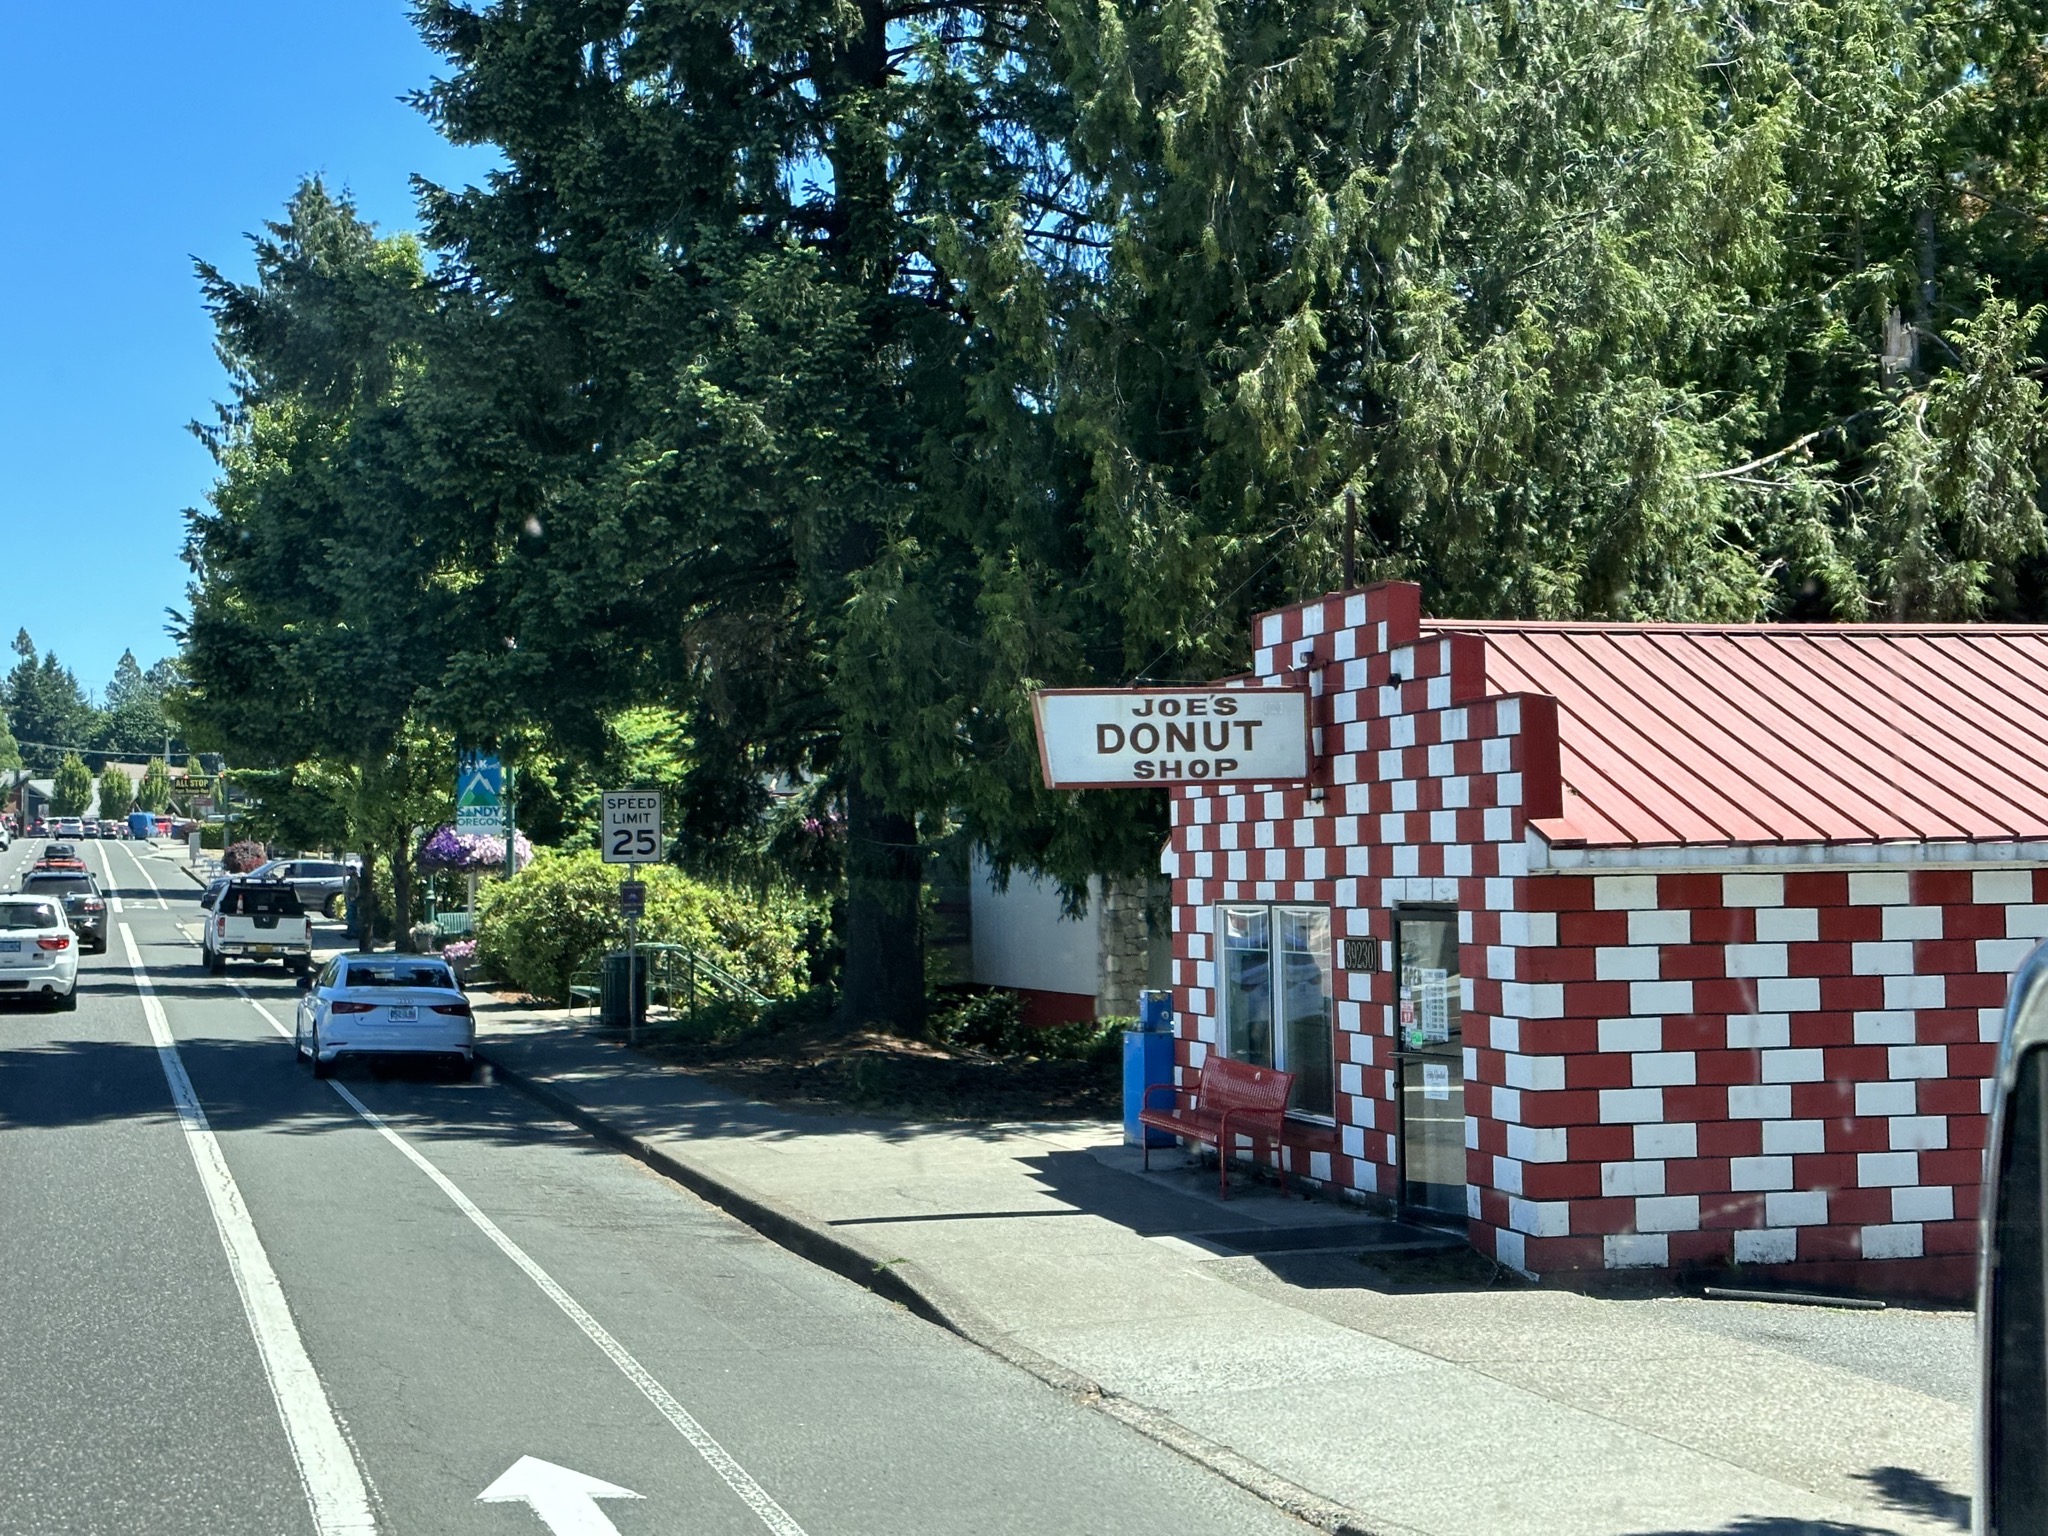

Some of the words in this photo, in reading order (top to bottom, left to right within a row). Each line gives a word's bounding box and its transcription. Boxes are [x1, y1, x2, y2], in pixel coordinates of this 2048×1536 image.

[1131, 694, 1239, 718] JOE'S
[1096, 720, 1263, 755] DONUT
[1133, 758, 1239, 780] SHOP
[190, 779, 209, 788] STOP
[457, 806, 501, 817] SANDY
[607, 798, 657, 810] SPEED
[457, 817, 503, 827] OREGON
[612, 812, 652, 825] LIMIT
[612, 829, 657, 856] 25
[1345, 941, 1374, 969] 39230
